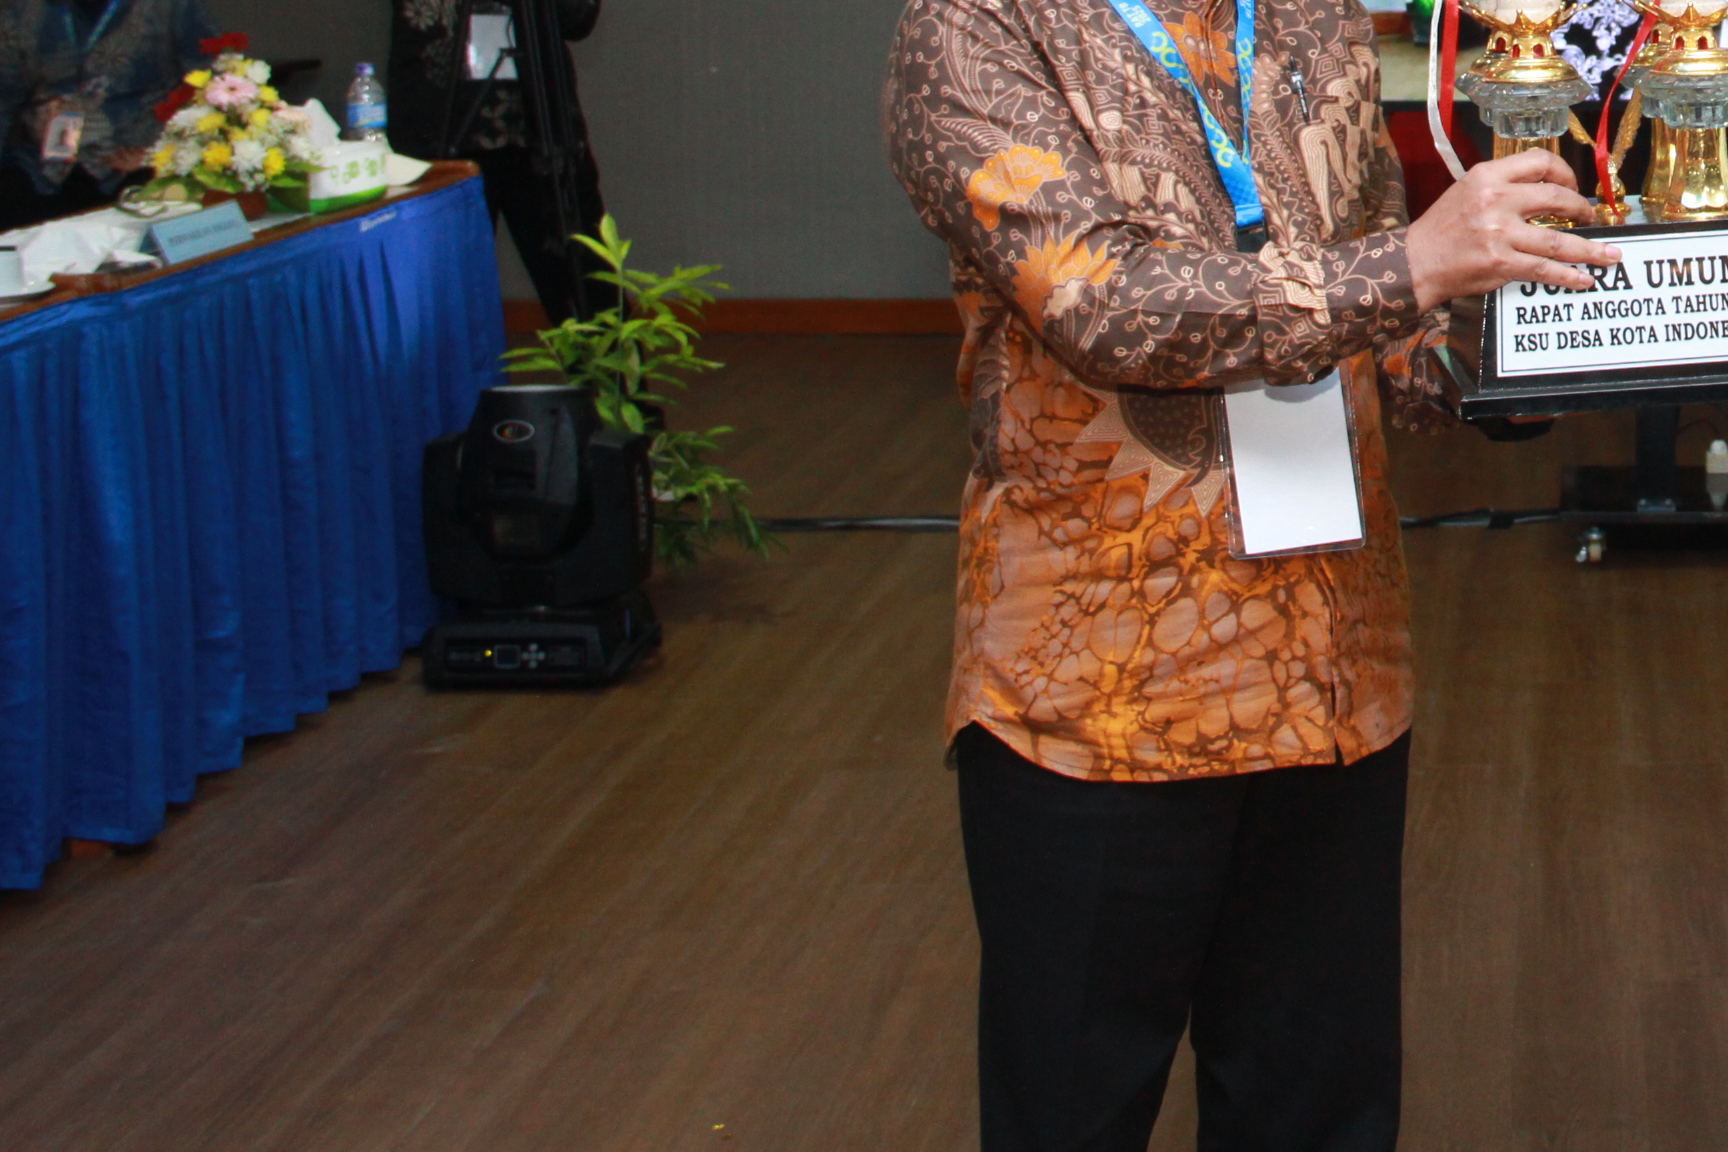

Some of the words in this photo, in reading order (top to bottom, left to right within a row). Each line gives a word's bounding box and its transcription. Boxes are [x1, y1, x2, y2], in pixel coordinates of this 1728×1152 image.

[1126, 9, 1147, 28] RAT
[1516, 302, 1575, 326] RAPAT
[1580, 297, 1667, 321] ANGGOTA
[1514, 332, 1550, 353] KSU
[1556, 328, 1604, 351] DESA
[1609, 325, 1659, 347] KOTA
